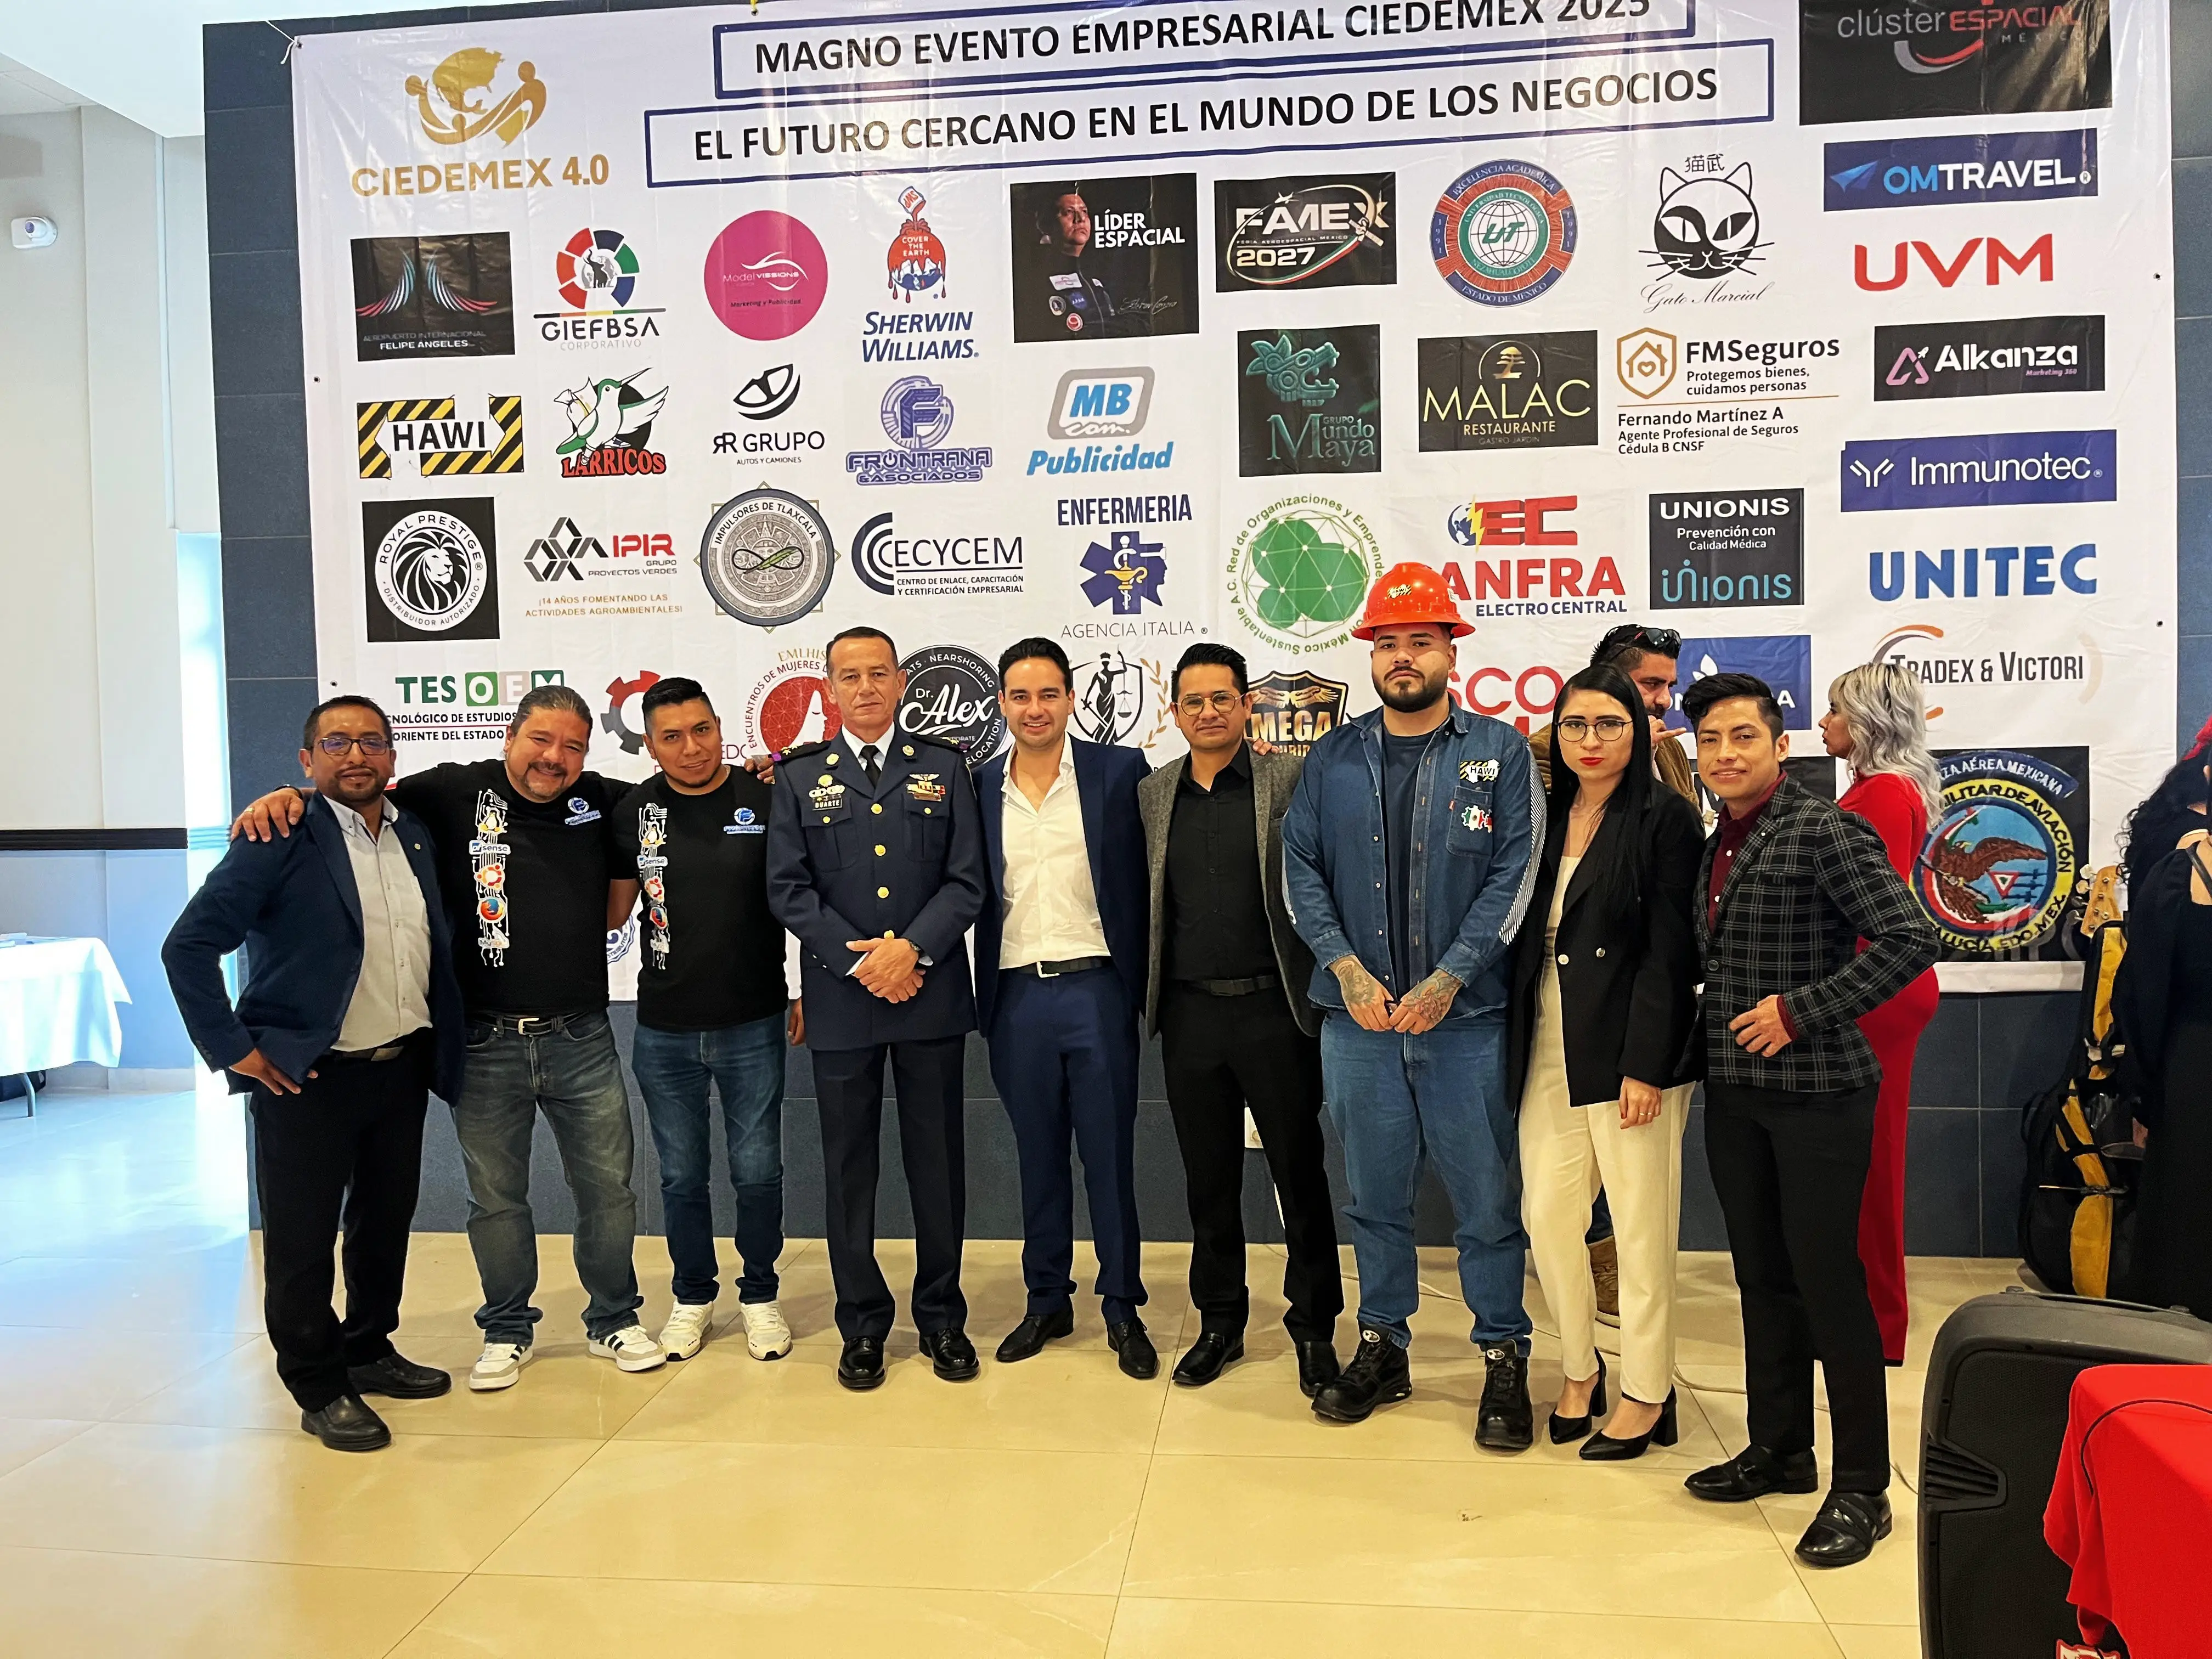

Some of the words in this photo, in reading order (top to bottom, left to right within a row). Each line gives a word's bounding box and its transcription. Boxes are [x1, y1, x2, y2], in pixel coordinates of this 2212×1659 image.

[757, 35, 901, 74] MAGNO
[915, 26, 1058, 65] EVENTO
[1073, 8, 1334, 54] EMPRESARIAL
[1346, 0, 1544, 37] CIEDEMEX
[696, 130, 731, 160] EL
[744, 121, 888, 158] FUTURO
[902, 110, 1075, 149] CERCANO
[1090, 106, 1135, 139] EN
[1150, 103, 1187, 134] EL
[1200, 93, 1353, 131] MUNDO
[1368, 88, 1414, 121] DE
[1429, 83, 1498, 117] LOS
[1513, 68, 1717, 111] NEGOCIOS
[352, 157, 552, 197] CIEDEMEX
[562, 154, 610, 185] 4.0
[1094, 208, 1146, 232] LÍDER
[1095, 227, 1186, 249] ESPACIAL
[1237, 246, 1316, 267] 2027
[1854, 233, 2053, 291] UVM
[1462, 286, 1496, 302] ESTADO
[864, 311, 973, 336] SHERWIN
[380, 341, 415, 350] FELIPE
[417, 340, 469, 348] ANGELES
[560, 339, 641, 352] CORPORATIVO
[1686, 339, 1840, 365] FMSeguros
[1935, 343, 2078, 372] Alkanza
[1687, 370, 1761, 383] Protegemos
[1766, 366, 1810, 377] bienes,
[1070, 383, 1132, 417] MB
[1686, 383, 1746, 396] cuidamos
[1750, 381, 1807, 394] personas
[1423, 379, 1590, 422] MALAC
[1323, 416, 1354, 424] GRUPO
[1618, 411, 1692, 426] Fernando
[1697, 408, 1767, 423] Martínez
[1772, 407, 1784, 420] A
[393, 421, 486, 452] HAWI
[1464, 421, 1556, 436] RESTAURANTE
[1618, 431, 1660, 443] Agente
[1664, 427, 1730, 439] Profesional
[1734, 426, 1747, 436] de
[1751, 425, 1798, 437] Seguros
[743, 431, 825, 452] GRUPO
[1618, 443, 1658, 454] Cédula
[1662, 442, 1669, 452] B
[1673, 442, 1705, 452] CNSF
[561, 448, 667, 478] LARRICOS
[1027, 441, 1173, 476] Publicidad
[1911, 452, 2091, 486] Immunotec
[1058, 494, 1192, 526] ENFERMERIA
[1661, 498, 1790, 520] UNIONIS
[714, 503, 759, 544] IMPULSORES
[762, 502, 774, 510] DE
[777, 503, 817, 539] TLAXCALA
[1227, 548, 1239, 573] Red
[1238, 530, 1249, 545] de
[1247, 493, 1342, 528] Organizaciones
[1343, 509, 1352, 518] y
[1677, 525, 1749, 539] Prevención
[1752, 527, 1775, 537] con
[380, 522, 413, 564] ROYAL
[418, 515, 482, 561] PRESTIGE
[1689, 540, 1728, 550] Calidad
[1730, 538, 1767, 549] Médica
[971, 574, 1023, 584] CAPACITACIÓN
[1870, 544, 2097, 601] UNITEC
[554, 595, 579, 604] AÑOS
[583, 594, 647, 603] FOMENTANDO
[905, 585, 964, 595] CERTIFICACIÓN
[968, 585, 1023, 594] EMPRESARIAL
[384, 588, 436, 625] DISTRIBUIDOR
[440, 585, 479, 625] AUTORIZADO
[526, 608, 586, 617] ACTIVIDADES
[1476, 603, 1548, 617] ELECTRO
[1551, 600, 1627, 615] CENTRAL
[1061, 623, 1137, 639] AGENCIA
[1144, 621, 1195, 636] ITALIA
[1237, 608, 1300, 654] Sustentable
[929, 653, 995, 688] NEARSHORING
[1981, 659, 1993, 681] &
[395, 675, 457, 703] TES
[916, 688, 934, 698] Dr.
[745, 682, 765, 748] ENCUENTROS
[763, 670, 776, 683] DE
[777, 661, 820, 675] MUJERES
[899, 684, 995, 733] Alex
[452, 714, 463, 722] DE
[1251, 710, 1331, 742] MEGA
[393, 731, 438, 741] ORIENTE
[442, 731, 460, 740] DEL
[464, 730, 504, 740] ESTADO
[966, 718, 1002, 765] ELOCATION
[1470, 766, 1496, 775] HAWI
[815, 799, 840, 809] DUARTE
